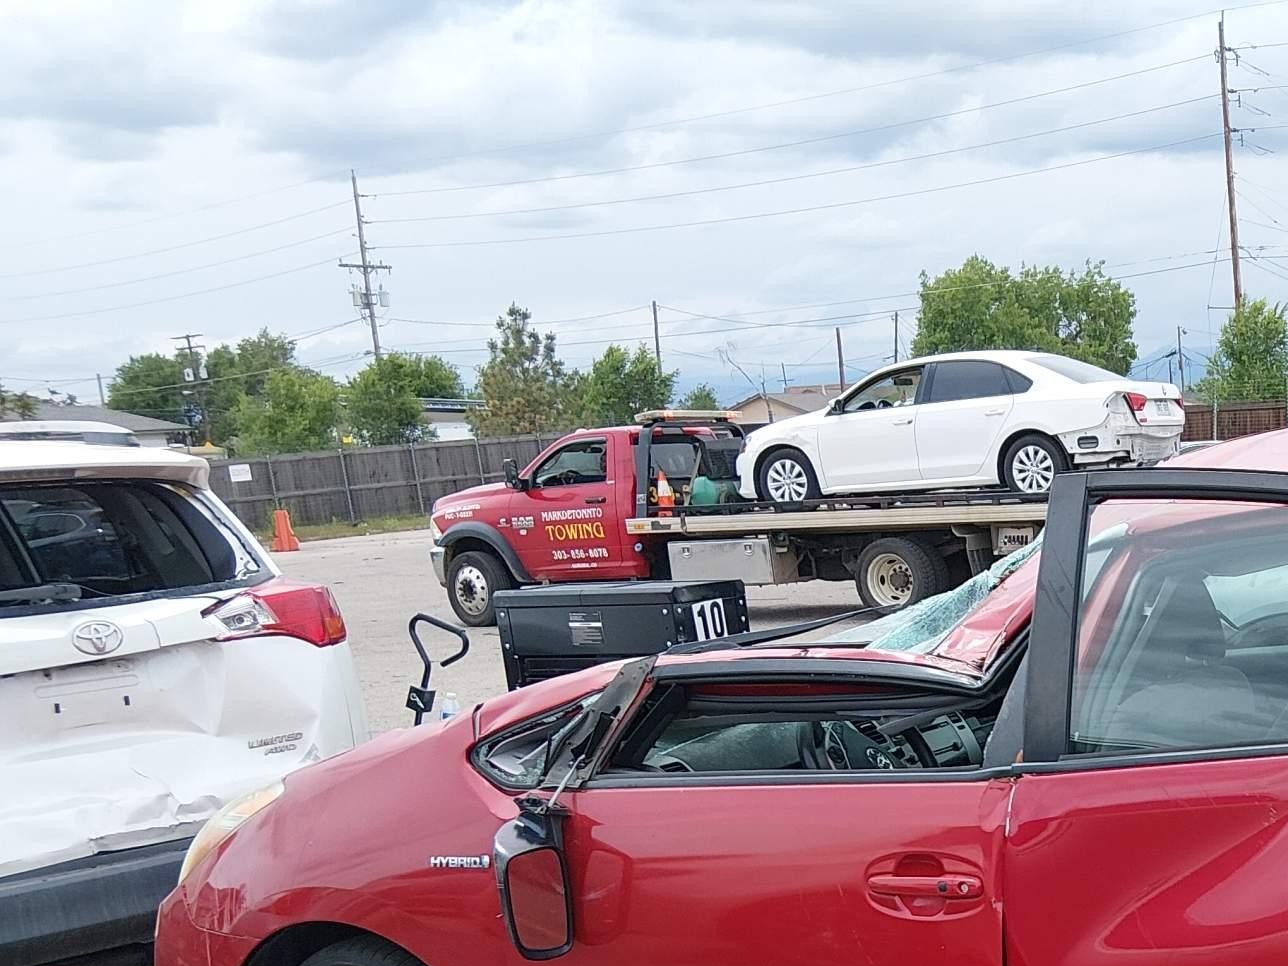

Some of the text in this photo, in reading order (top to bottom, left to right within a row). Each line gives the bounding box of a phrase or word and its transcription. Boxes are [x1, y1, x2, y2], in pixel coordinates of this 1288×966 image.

[545, 522, 605, 541] TOWING
[696, 601, 725, 641] 10
[430, 856, 481, 868] HYBRID
